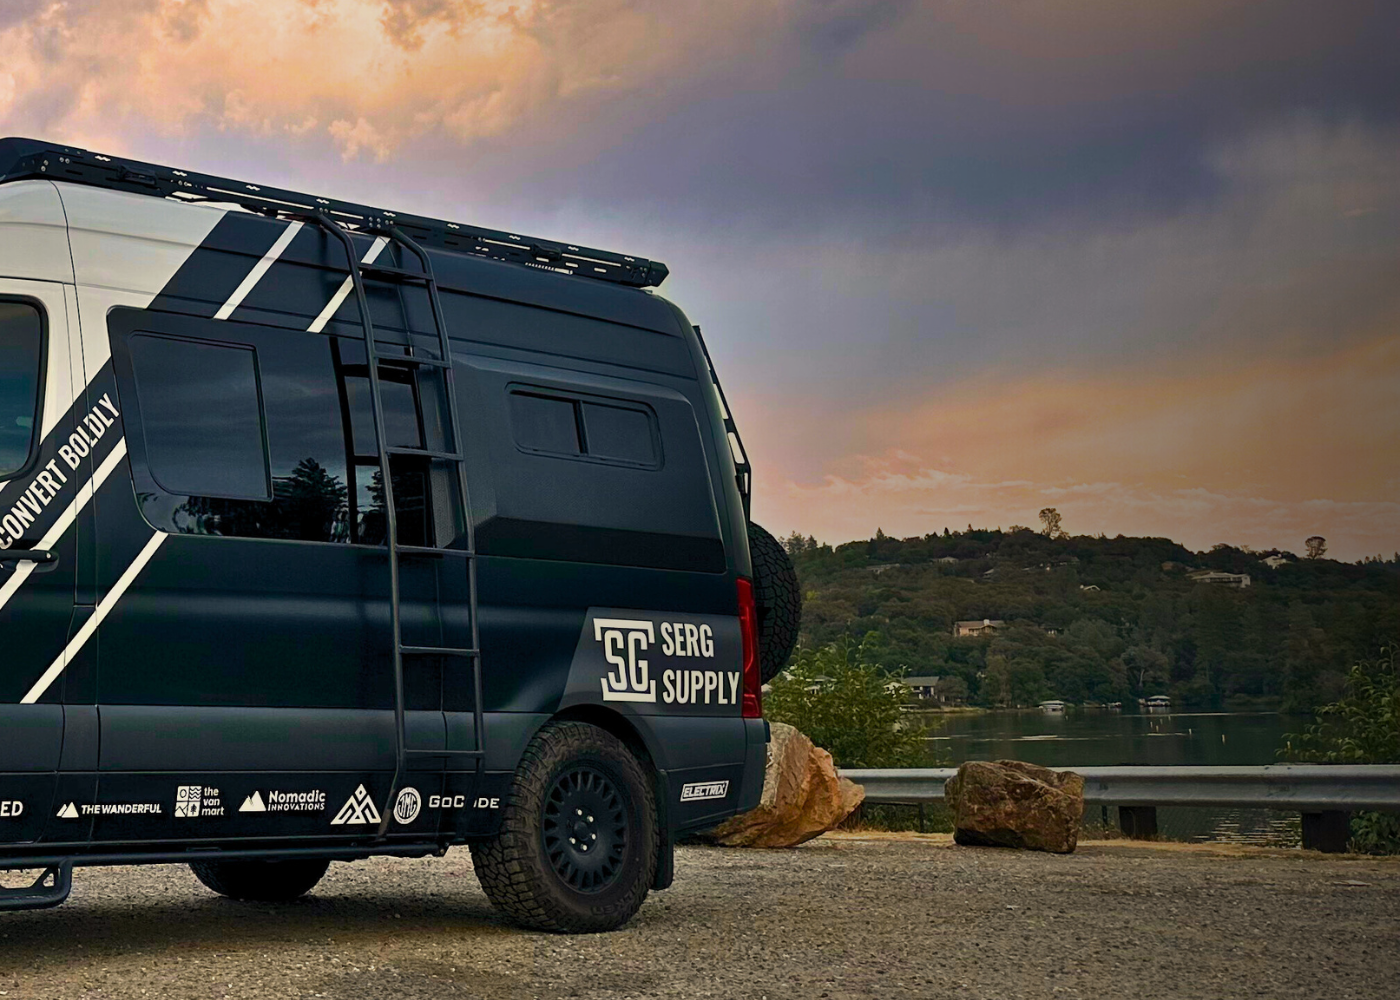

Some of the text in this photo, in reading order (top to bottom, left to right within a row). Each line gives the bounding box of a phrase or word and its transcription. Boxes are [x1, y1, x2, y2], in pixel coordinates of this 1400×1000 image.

[58, 393, 120, 470] BOLDLY
[661, 621, 714, 657] SERG
[604, 630, 648, 691] SG
[662, 669, 740, 704] SUPPLY
[203, 786, 219, 797] the
[268, 789, 326, 803] Nomadic
[203, 798, 220, 806] van
[267, 803, 325, 811] INNOVATIONS
[81, 803, 162, 814] THE WANDERFUL
[201, 806, 225, 816] mart
